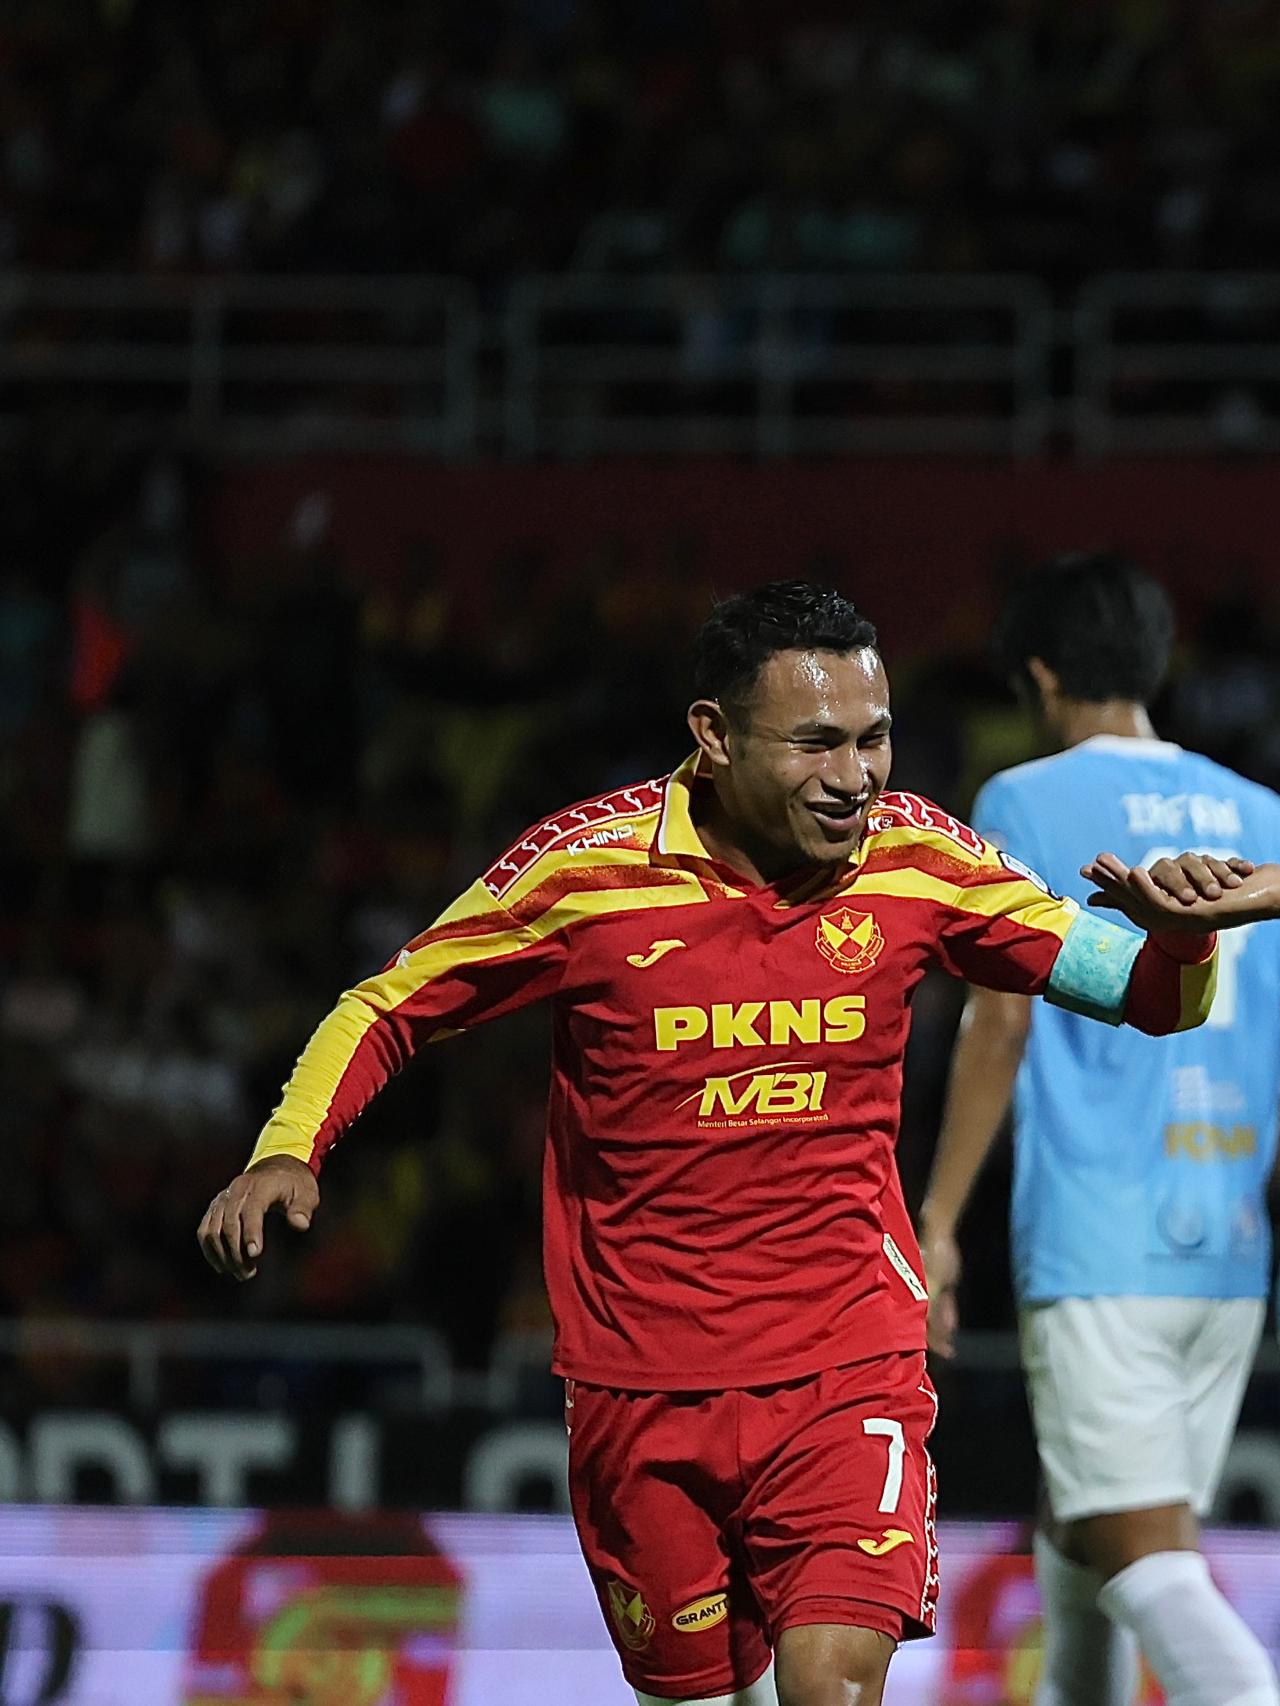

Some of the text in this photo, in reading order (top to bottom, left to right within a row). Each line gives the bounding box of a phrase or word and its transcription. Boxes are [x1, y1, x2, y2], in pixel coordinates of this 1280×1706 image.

[566, 824, 634, 856] KHIND
[653, 995, 866, 1051] PKNS
[698, 1071, 828, 1116] MBI
[749, 1117, 781, 1127] Selangor
[783, 1114, 829, 1124] Incorporated
[862, 1417, 905, 1513] 7
